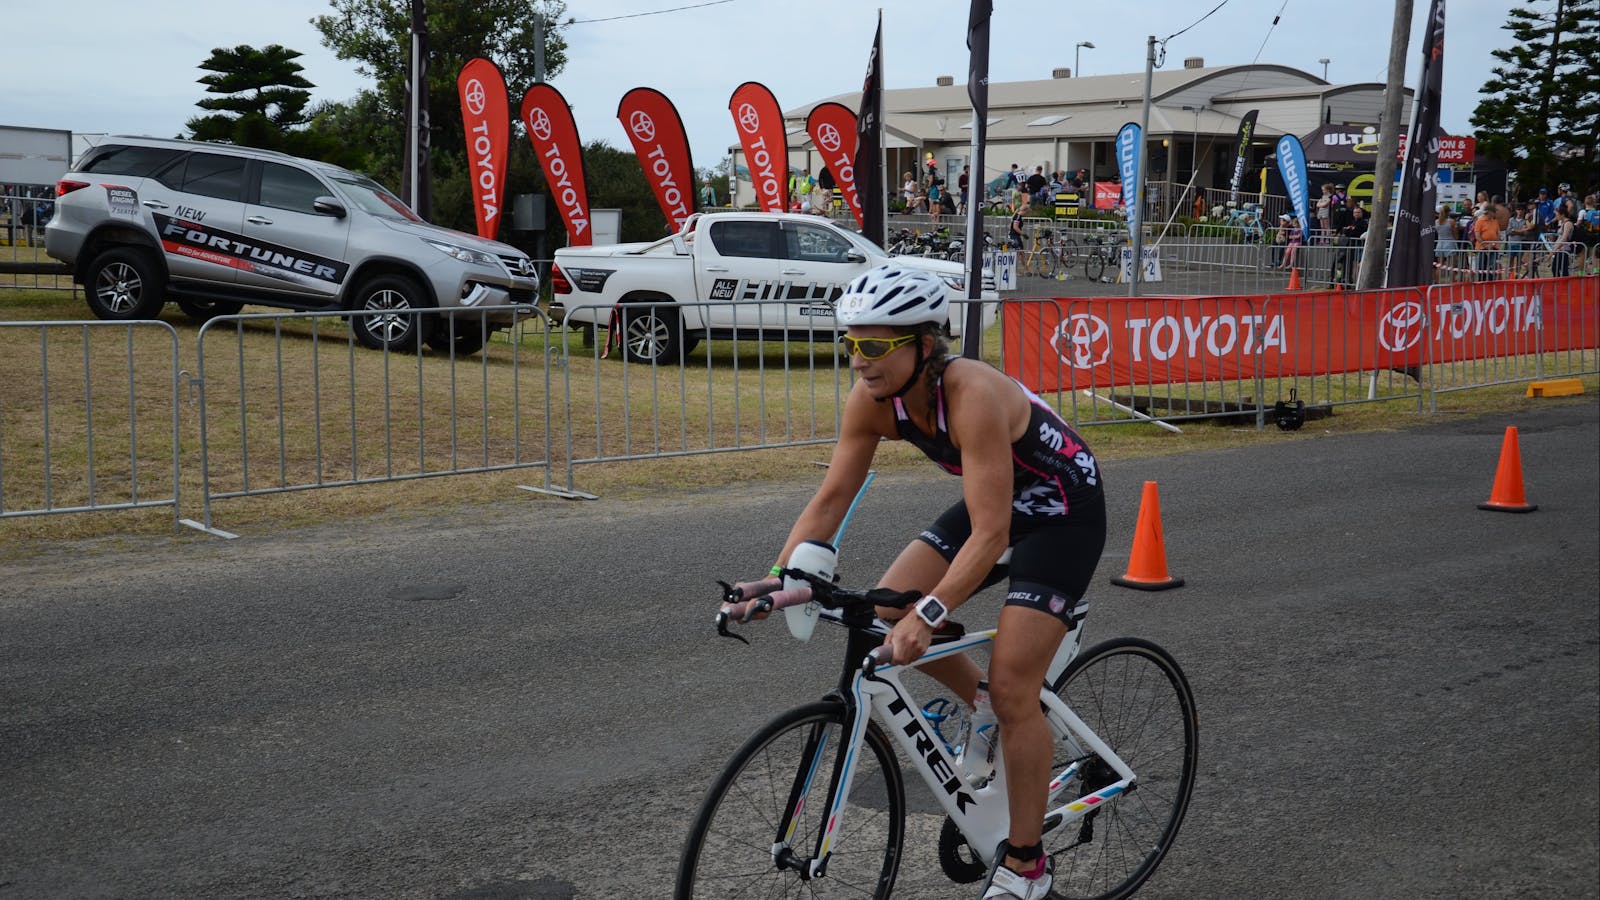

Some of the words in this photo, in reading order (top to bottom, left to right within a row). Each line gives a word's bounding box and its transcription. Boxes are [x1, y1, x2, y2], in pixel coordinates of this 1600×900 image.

[1458, 140, 1466, 149] &
[473, 120, 498, 222] TOYOTA
[834, 153, 862, 218] TOYO
[545, 143, 588, 236] TOYOTA
[174, 205, 207, 221] NEW
[163, 224, 337, 280] FORTUNER
[997, 255, 1015, 266] ROW
[1002, 268, 1009, 283] 4
[1148, 261, 1155, 275] 2
[712, 289, 734, 298] NEW
[850, 297, 864, 308] 61
[1435, 295, 1544, 341] TOYOTA
[1125, 314, 1287, 362] TOYOTA
[887, 697, 978, 816] TREK
